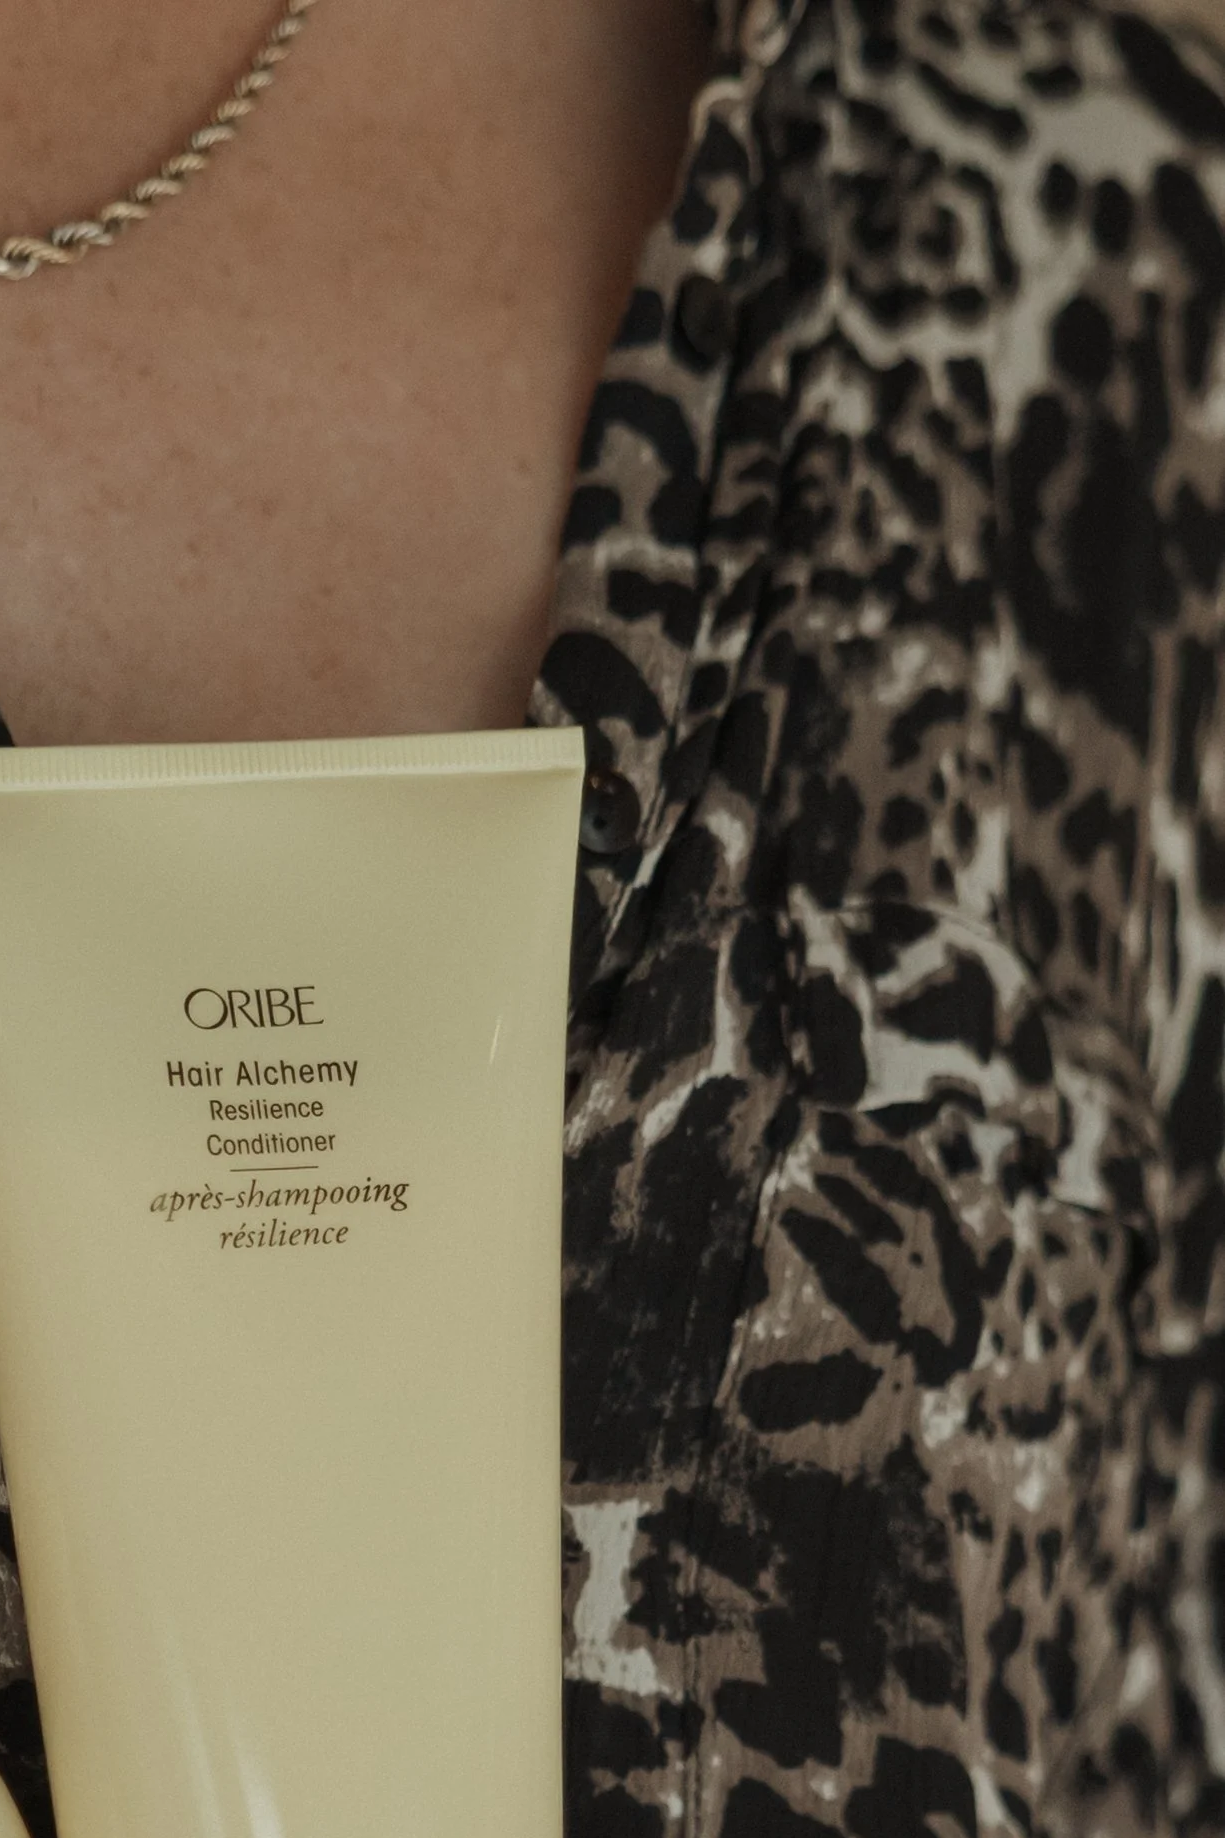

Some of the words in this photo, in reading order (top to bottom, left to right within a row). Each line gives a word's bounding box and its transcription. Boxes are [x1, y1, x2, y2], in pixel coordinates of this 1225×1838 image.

[183, 985, 324, 1030] ORIBE
[166, 1060, 224, 1087] Hair
[235, 1060, 359, 1086] Alchemy
[209, 1099, 325, 1121] Resilience
[206, 1132, 337, 1156] Conditioner
[149, 1176, 410, 1223] après-shampooing
[219, 1218, 350, 1250] résilience
